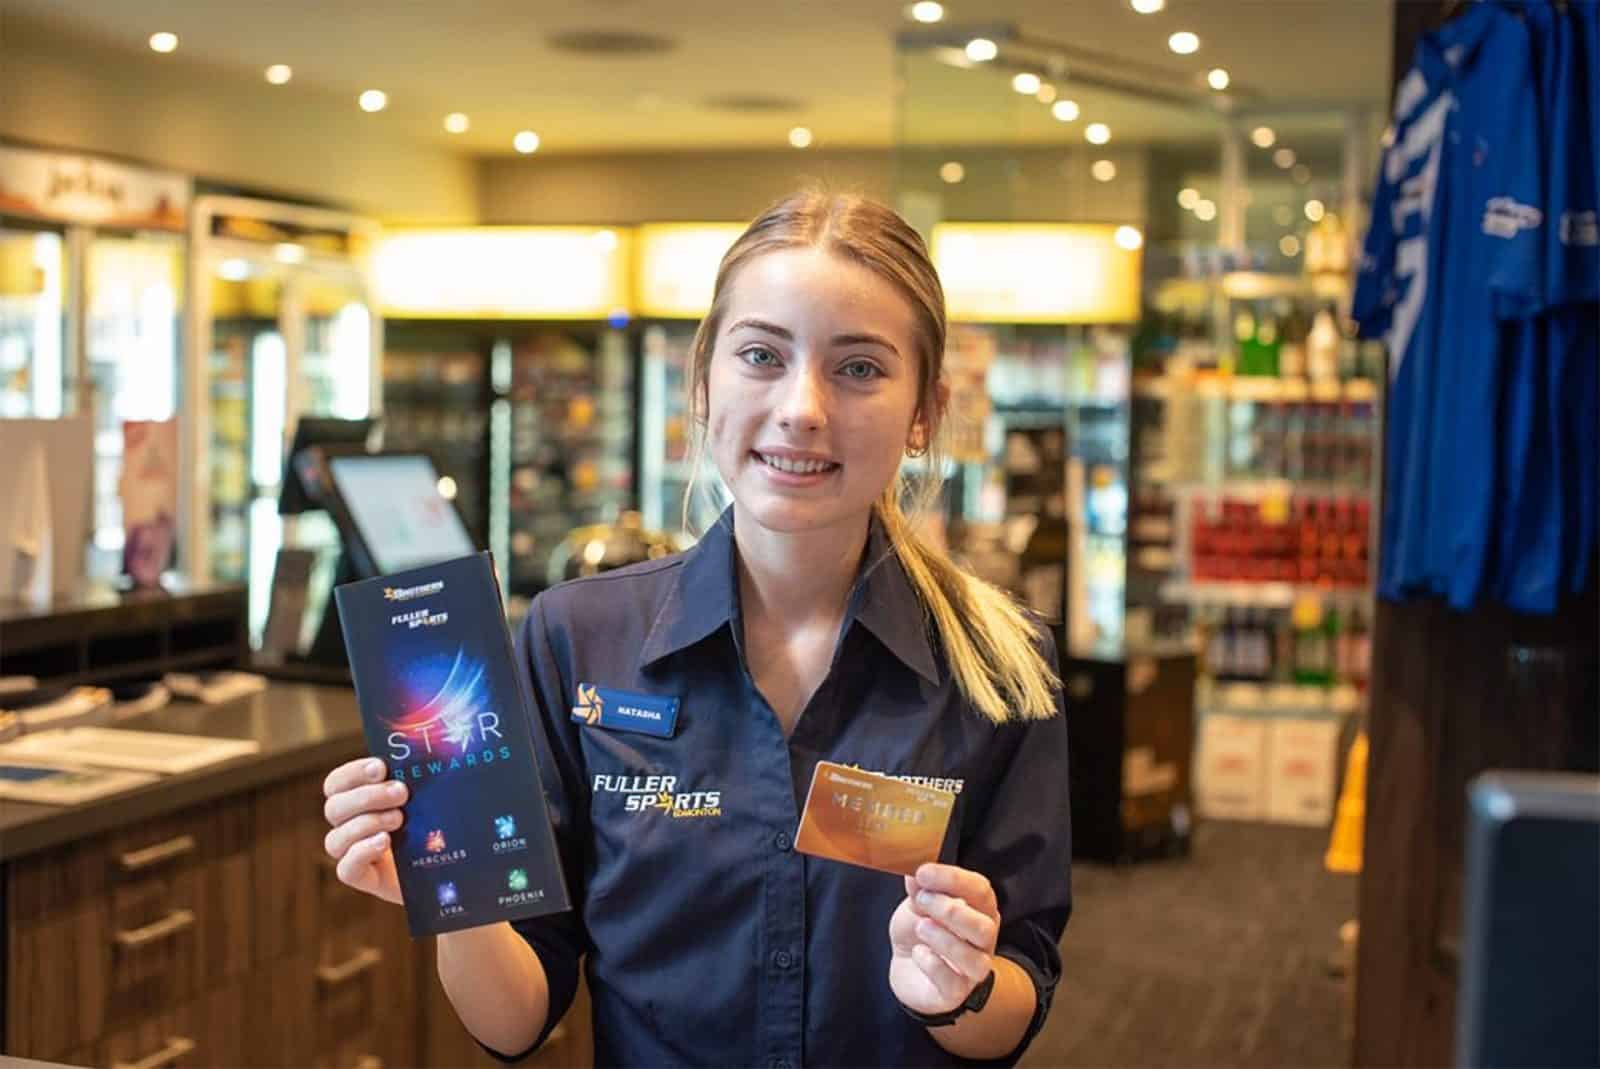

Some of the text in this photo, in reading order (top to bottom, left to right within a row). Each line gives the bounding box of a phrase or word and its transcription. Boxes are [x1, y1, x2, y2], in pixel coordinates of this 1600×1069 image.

[391, 608, 429, 625] FULLER
[617, 705, 662, 720] NATASHA
[393, 745, 512, 780] REWARDS
[593, 774, 677, 793] FULLER
[492, 838, 526, 852] ORION
[412, 848, 467, 867] HERCULES
[498, 889, 544, 905] PHOENIX
[440, 904, 464, 917] LYRA
